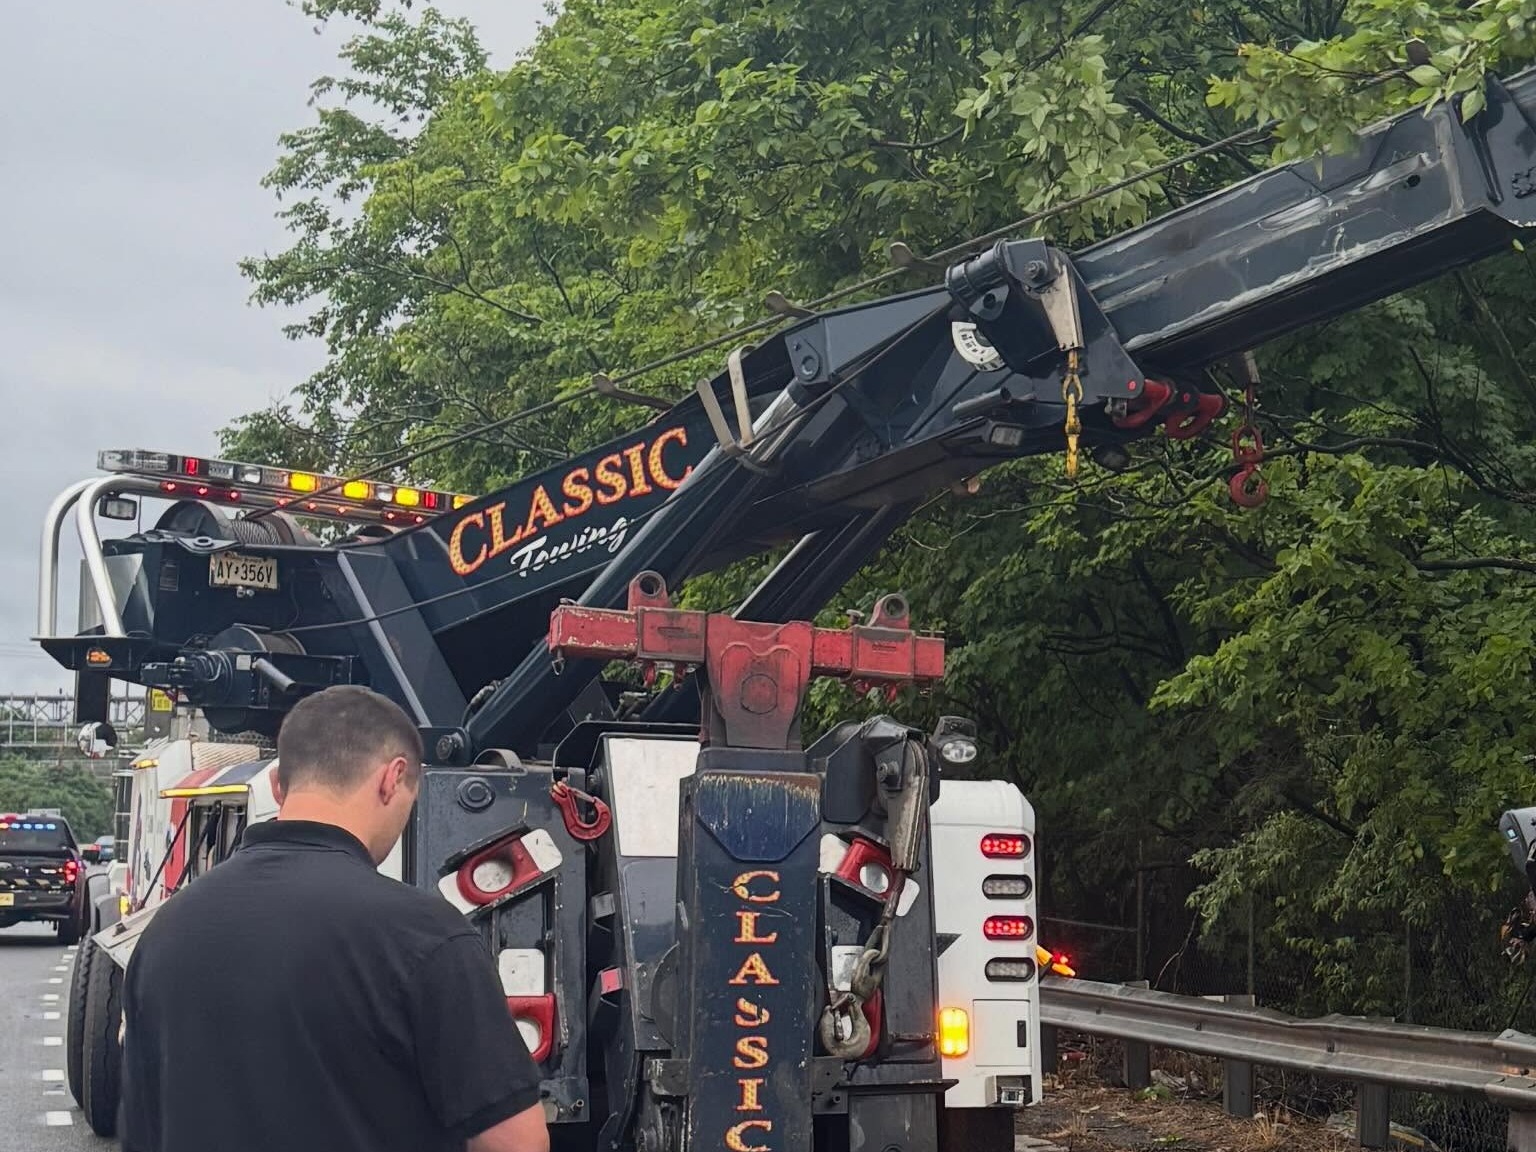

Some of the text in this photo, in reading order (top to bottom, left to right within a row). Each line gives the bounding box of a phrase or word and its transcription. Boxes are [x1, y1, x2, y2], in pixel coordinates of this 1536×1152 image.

[449, 426, 694, 577] CLASSIC
[510, 516, 635, 577] Towing
[726, 869, 780, 1152] CLASSIC
